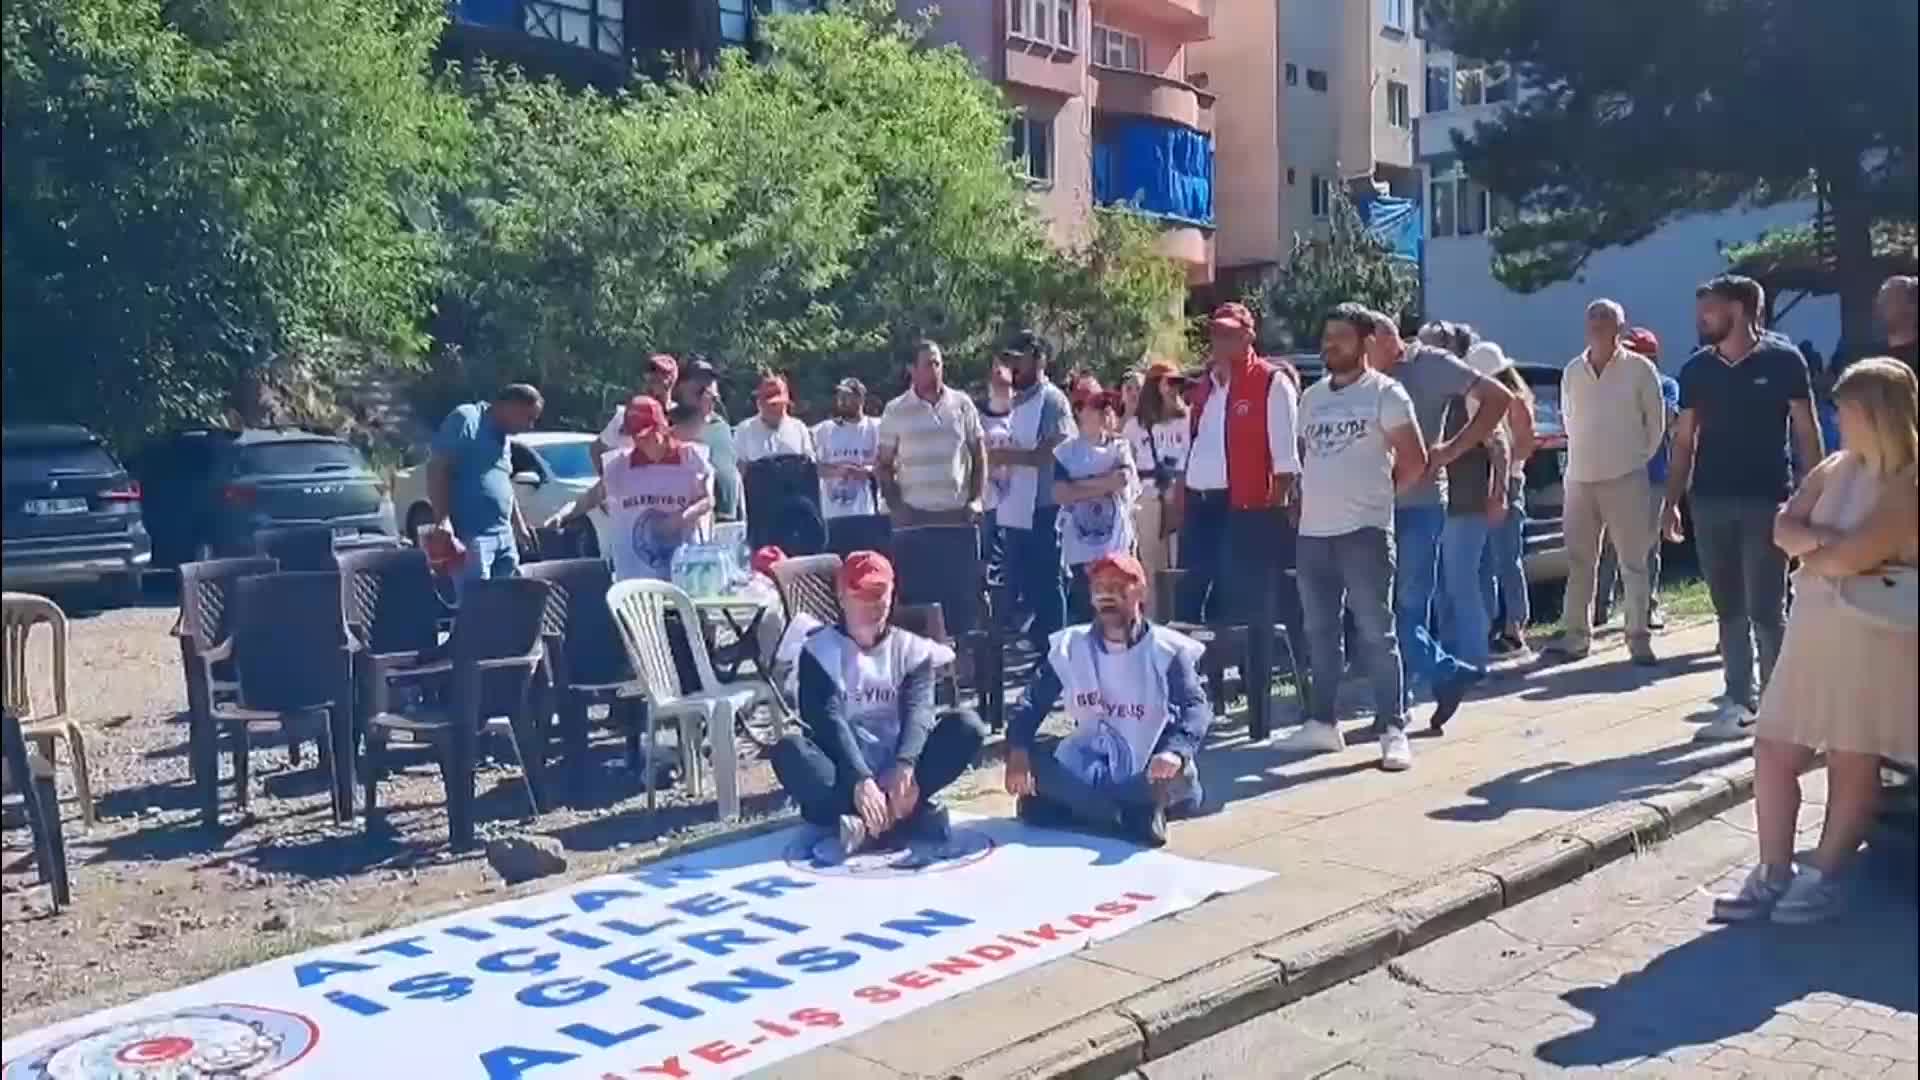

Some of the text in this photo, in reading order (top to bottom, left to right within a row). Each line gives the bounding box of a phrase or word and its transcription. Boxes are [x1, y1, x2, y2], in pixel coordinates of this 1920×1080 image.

[294, 864, 714, 988] ATILAN
[322, 876, 817, 1016] İŞÇİLER
[479, 907, 977, 1080] ALINSIN
[514, 912, 811, 1008] GERİ
[602, 891, 1157, 1080] YE-İŞ SENDİKASI
